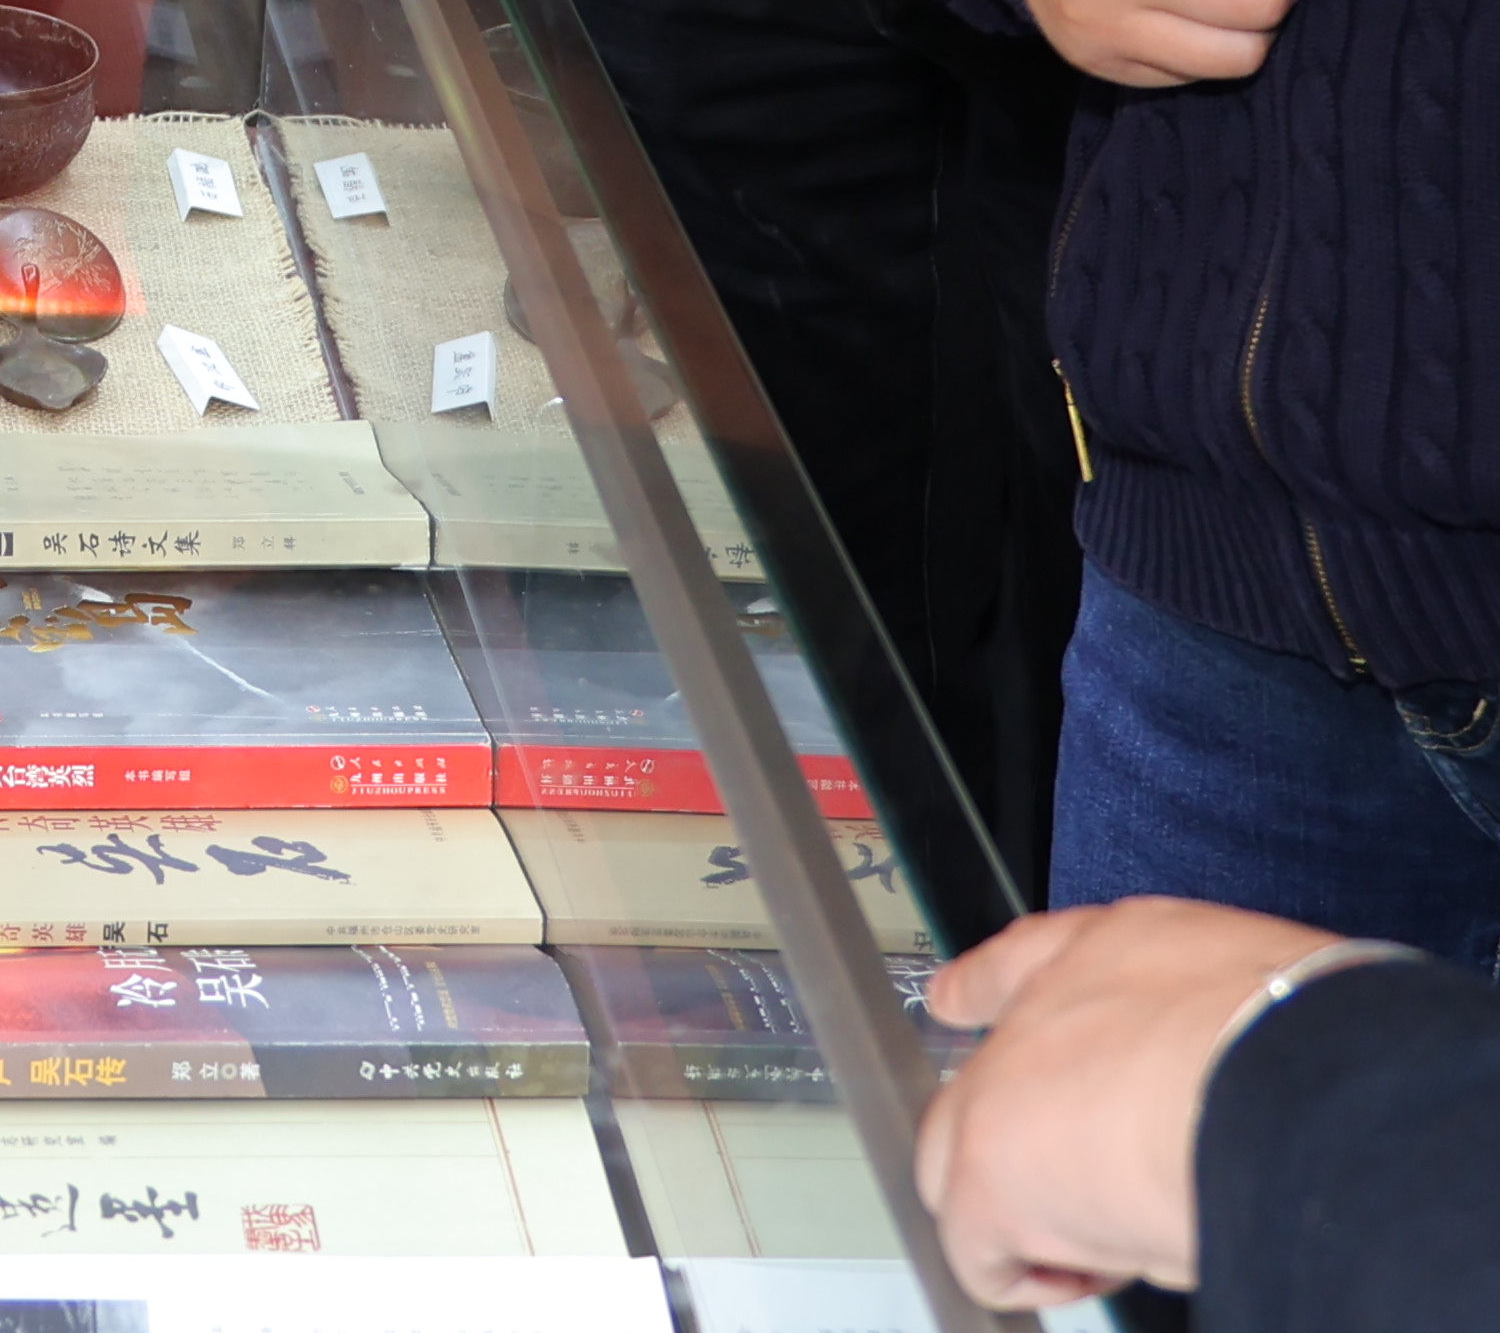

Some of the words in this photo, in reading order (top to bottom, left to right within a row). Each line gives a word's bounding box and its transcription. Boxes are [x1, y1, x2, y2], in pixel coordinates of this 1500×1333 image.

[43, 530, 201, 558] 吴石诗文集
[102, 921, 170, 945] 吴石
[30, 1057, 127, 1085] 吴石传
